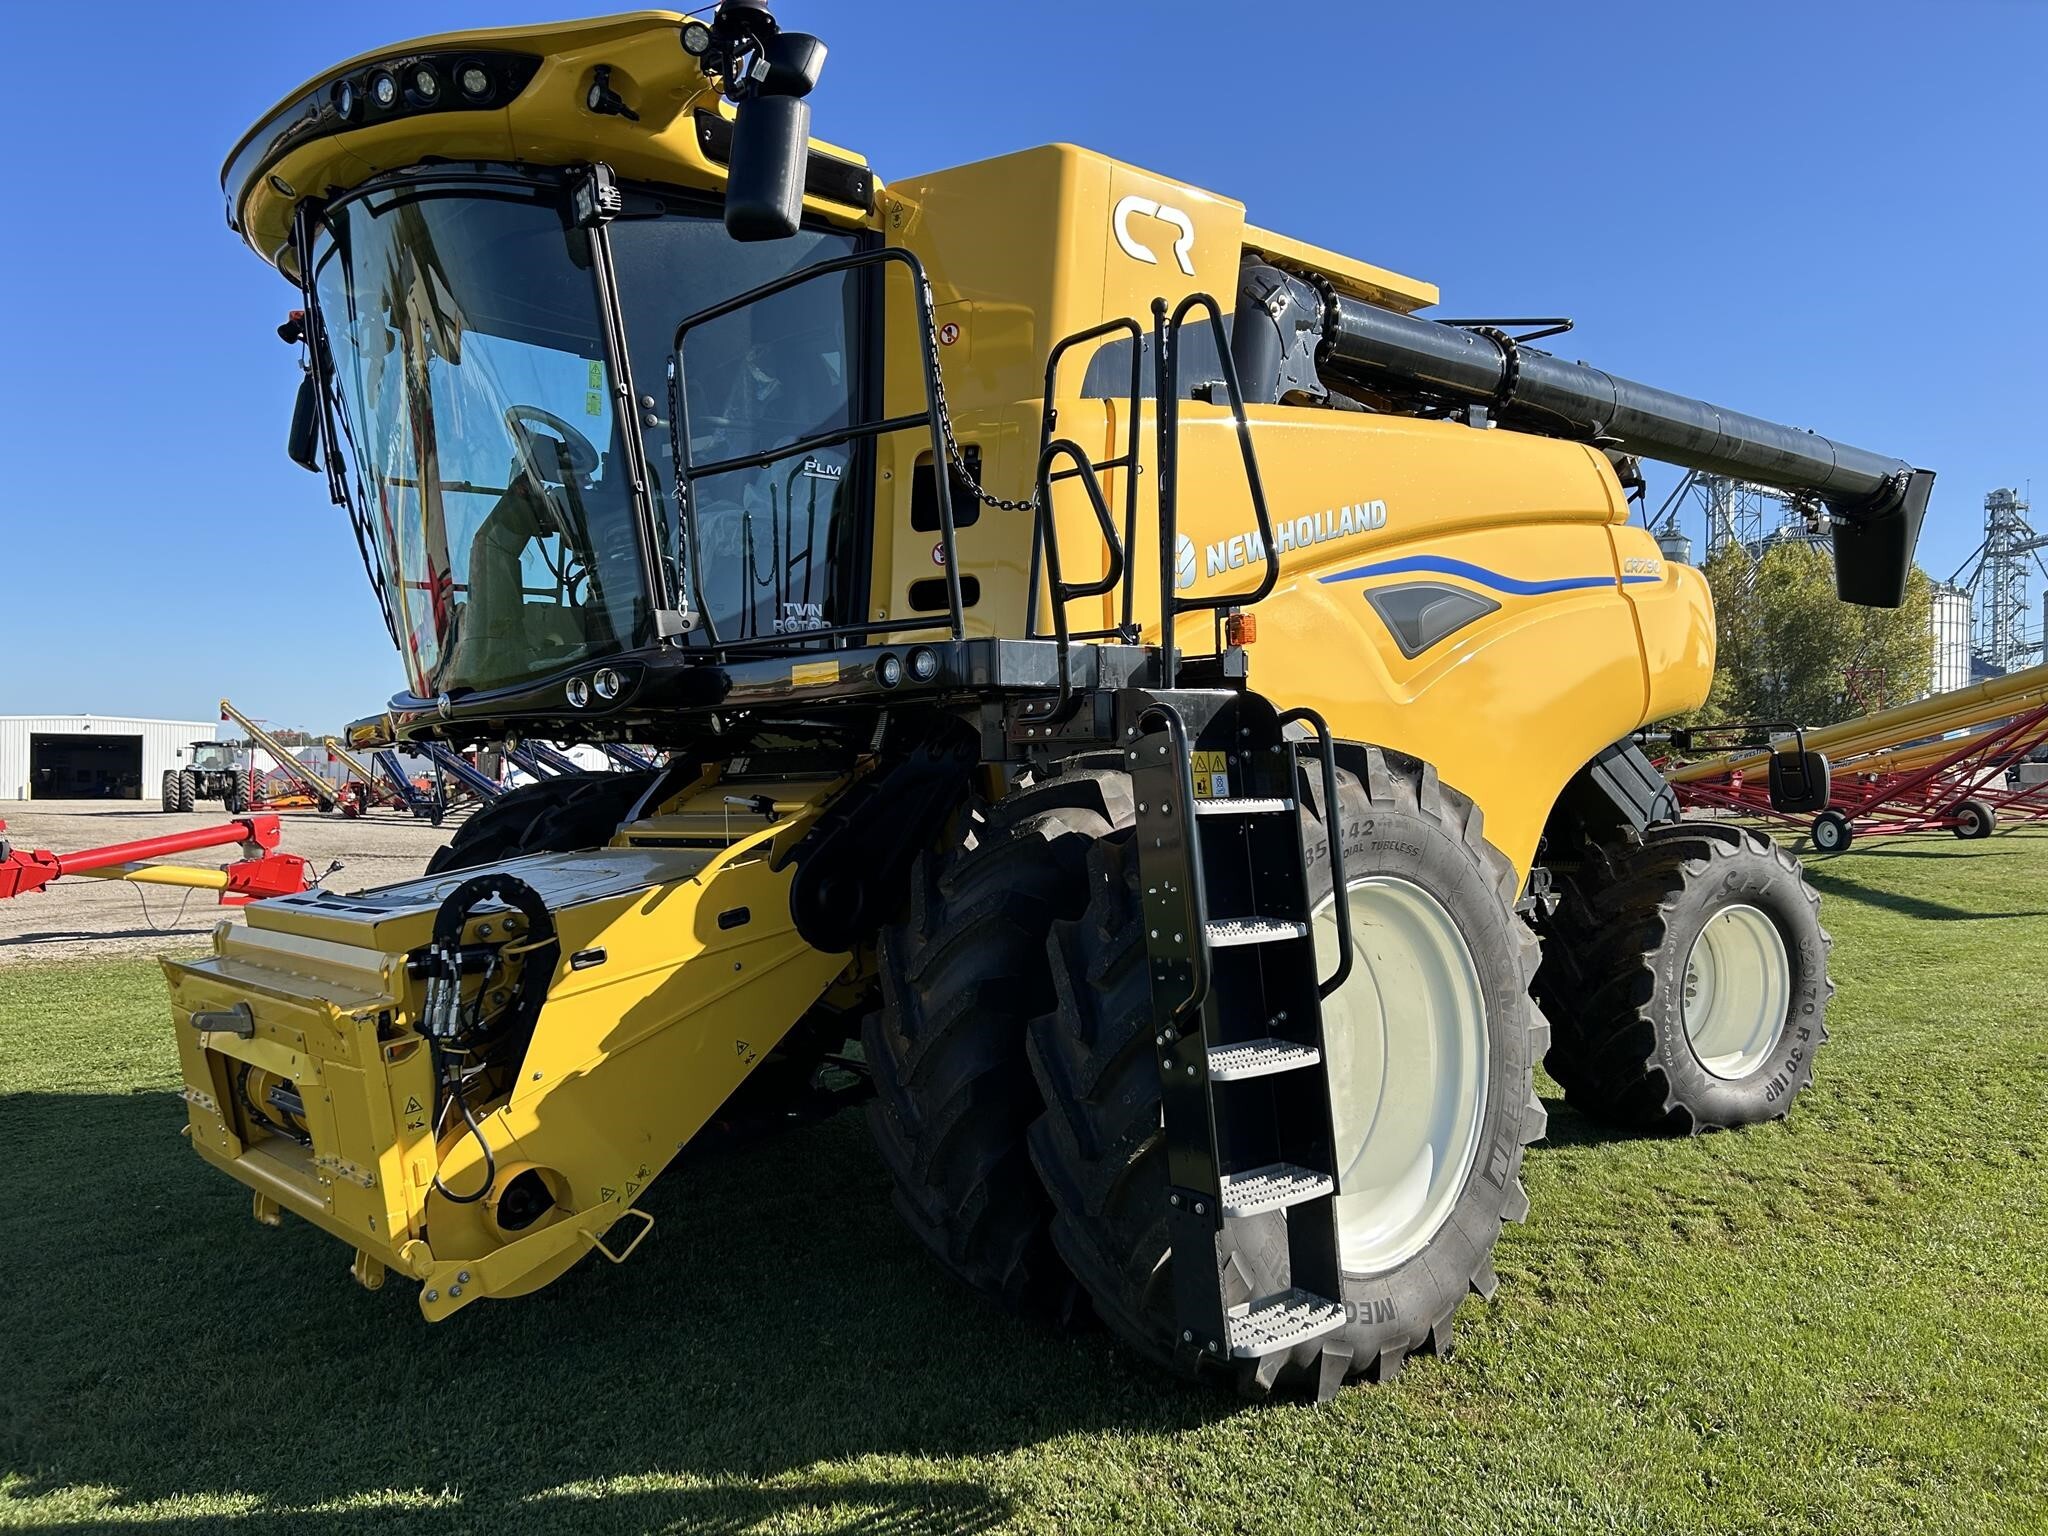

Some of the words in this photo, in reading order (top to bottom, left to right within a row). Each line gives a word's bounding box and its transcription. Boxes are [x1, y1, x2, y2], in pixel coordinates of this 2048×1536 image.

[1113, 195, 1195, 276] CR
[803, 460, 842, 476] PLM
[1205, 531, 1267, 577] NEW
[1274, 499, 1388, 555] HOLLAND
[783, 602, 823, 617] TWIN
[773, 616, 833, 634] ROTOR
[1349, 819, 1376, 838] 42
[1343, 842, 1364, 859] DIAL
[1370, 839, 1421, 857] TUBELESS
[1796, 1026, 1811, 1043] R
[1785, 1048, 1804, 1075] 30
[1765, 1072, 1790, 1103] IMP
